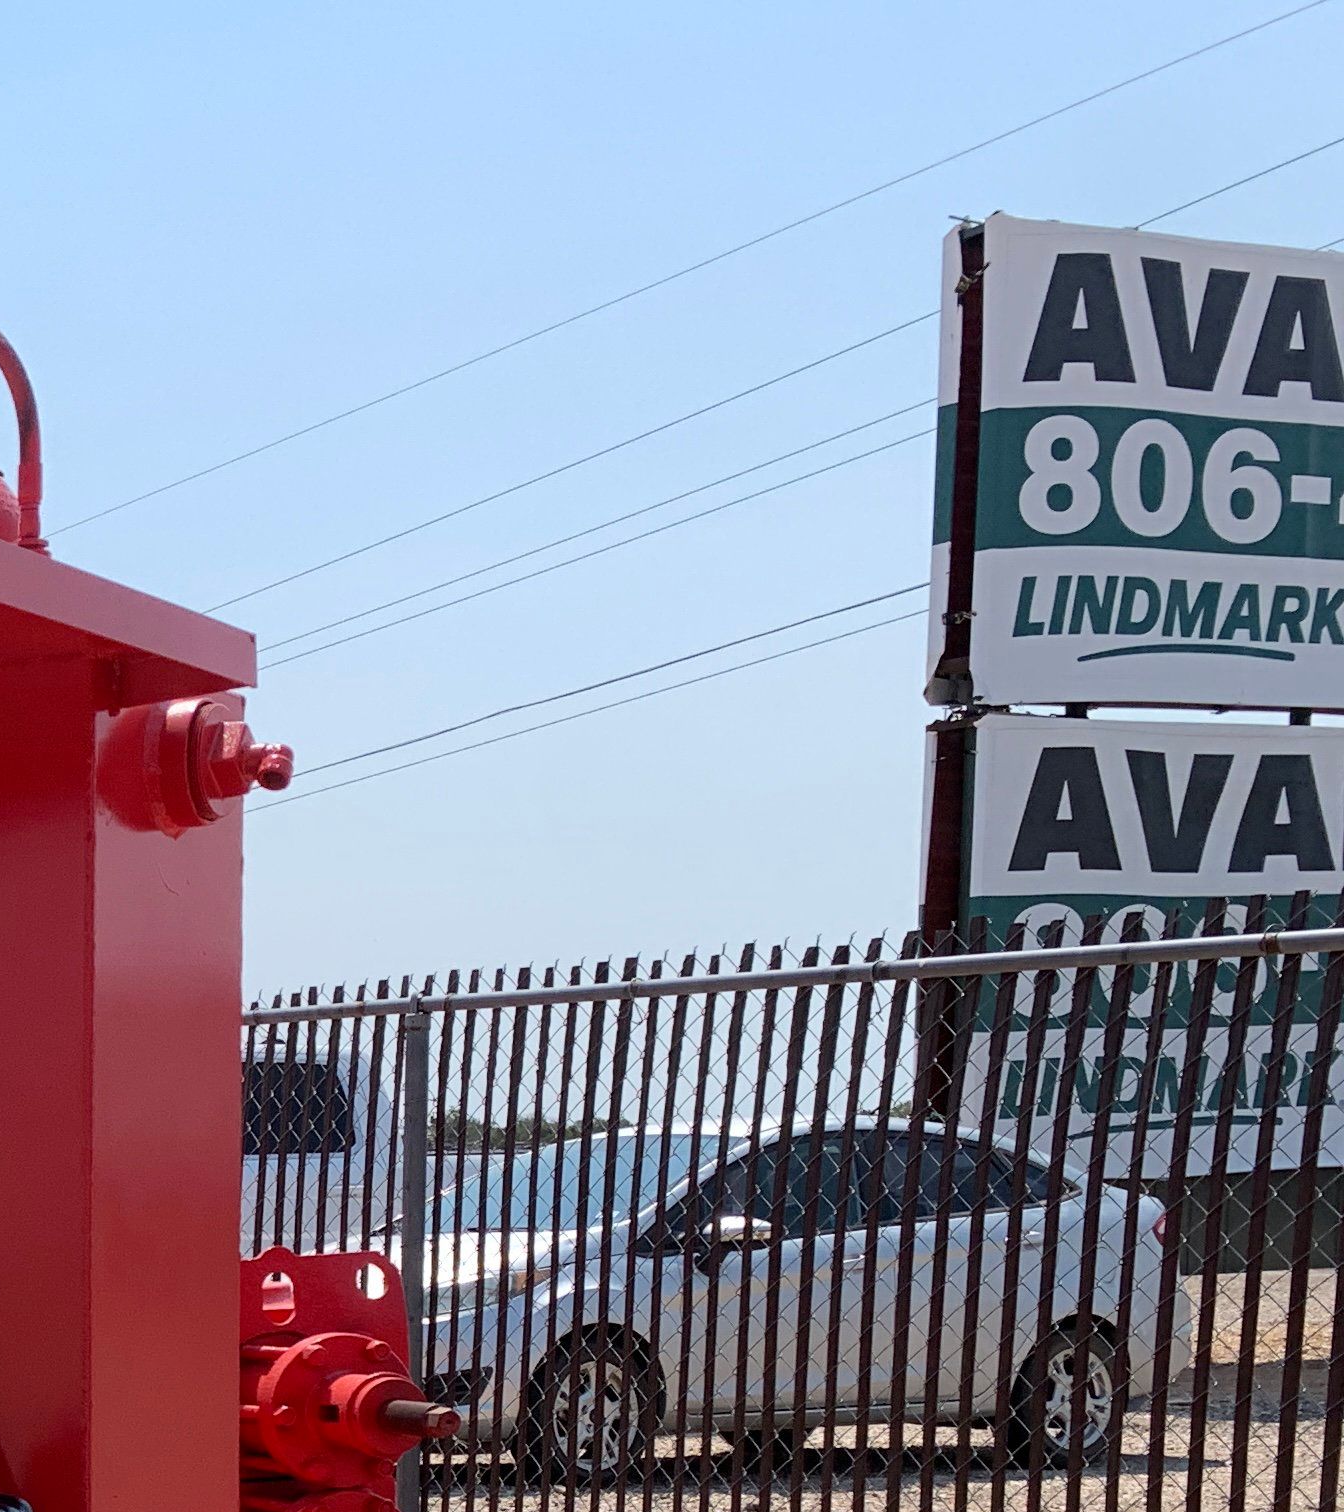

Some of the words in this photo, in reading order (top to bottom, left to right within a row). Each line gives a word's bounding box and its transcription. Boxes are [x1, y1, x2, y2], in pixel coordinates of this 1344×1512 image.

[1018, 414, 1344, 544] 806-
[1012, 574, 1344, 645] LINDMARK
[1007, 746, 1344, 874] AVA
